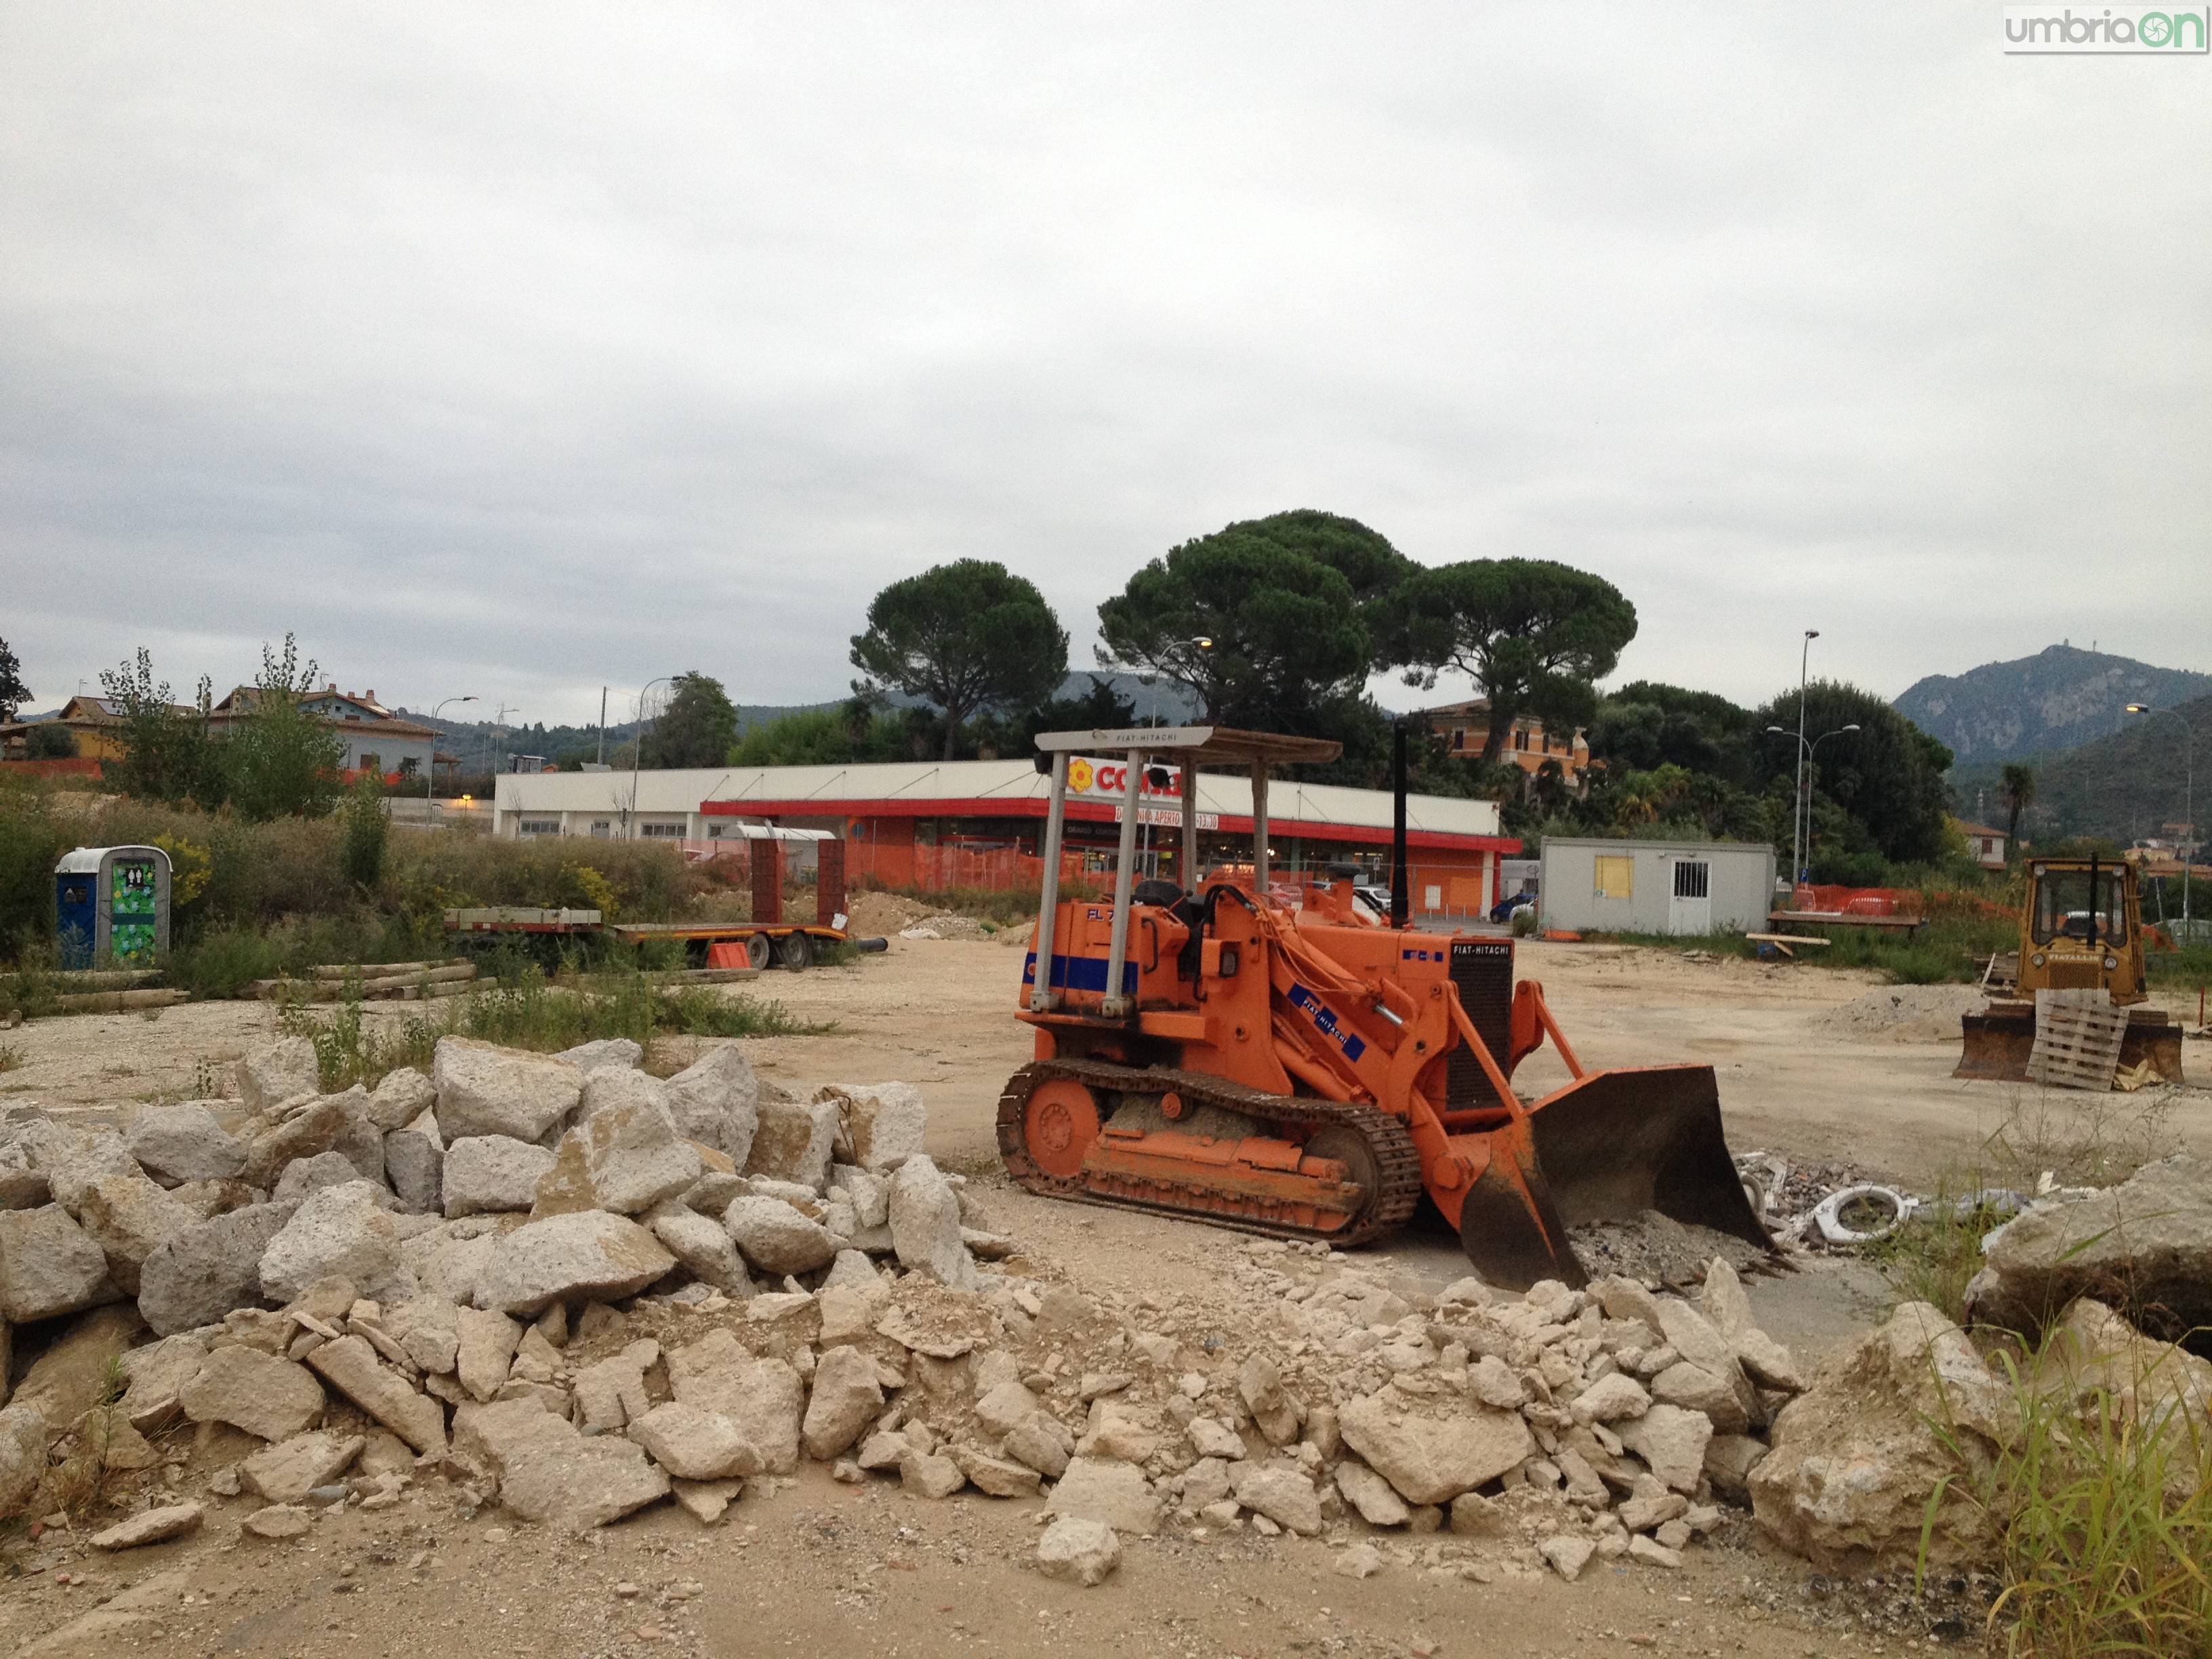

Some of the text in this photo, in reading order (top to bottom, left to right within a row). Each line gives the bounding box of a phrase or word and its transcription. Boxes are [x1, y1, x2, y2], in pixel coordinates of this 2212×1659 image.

[1116, 734, 1177, 742] FIAT-HITACHI
[1155, 811, 1180, 825] APERTO
[1087, 908, 1105, 921] FL
[1454, 945, 1509, 955] FIAT-HITACHI
[1303, 999, 1347, 1044] FIAT-HITACHI
